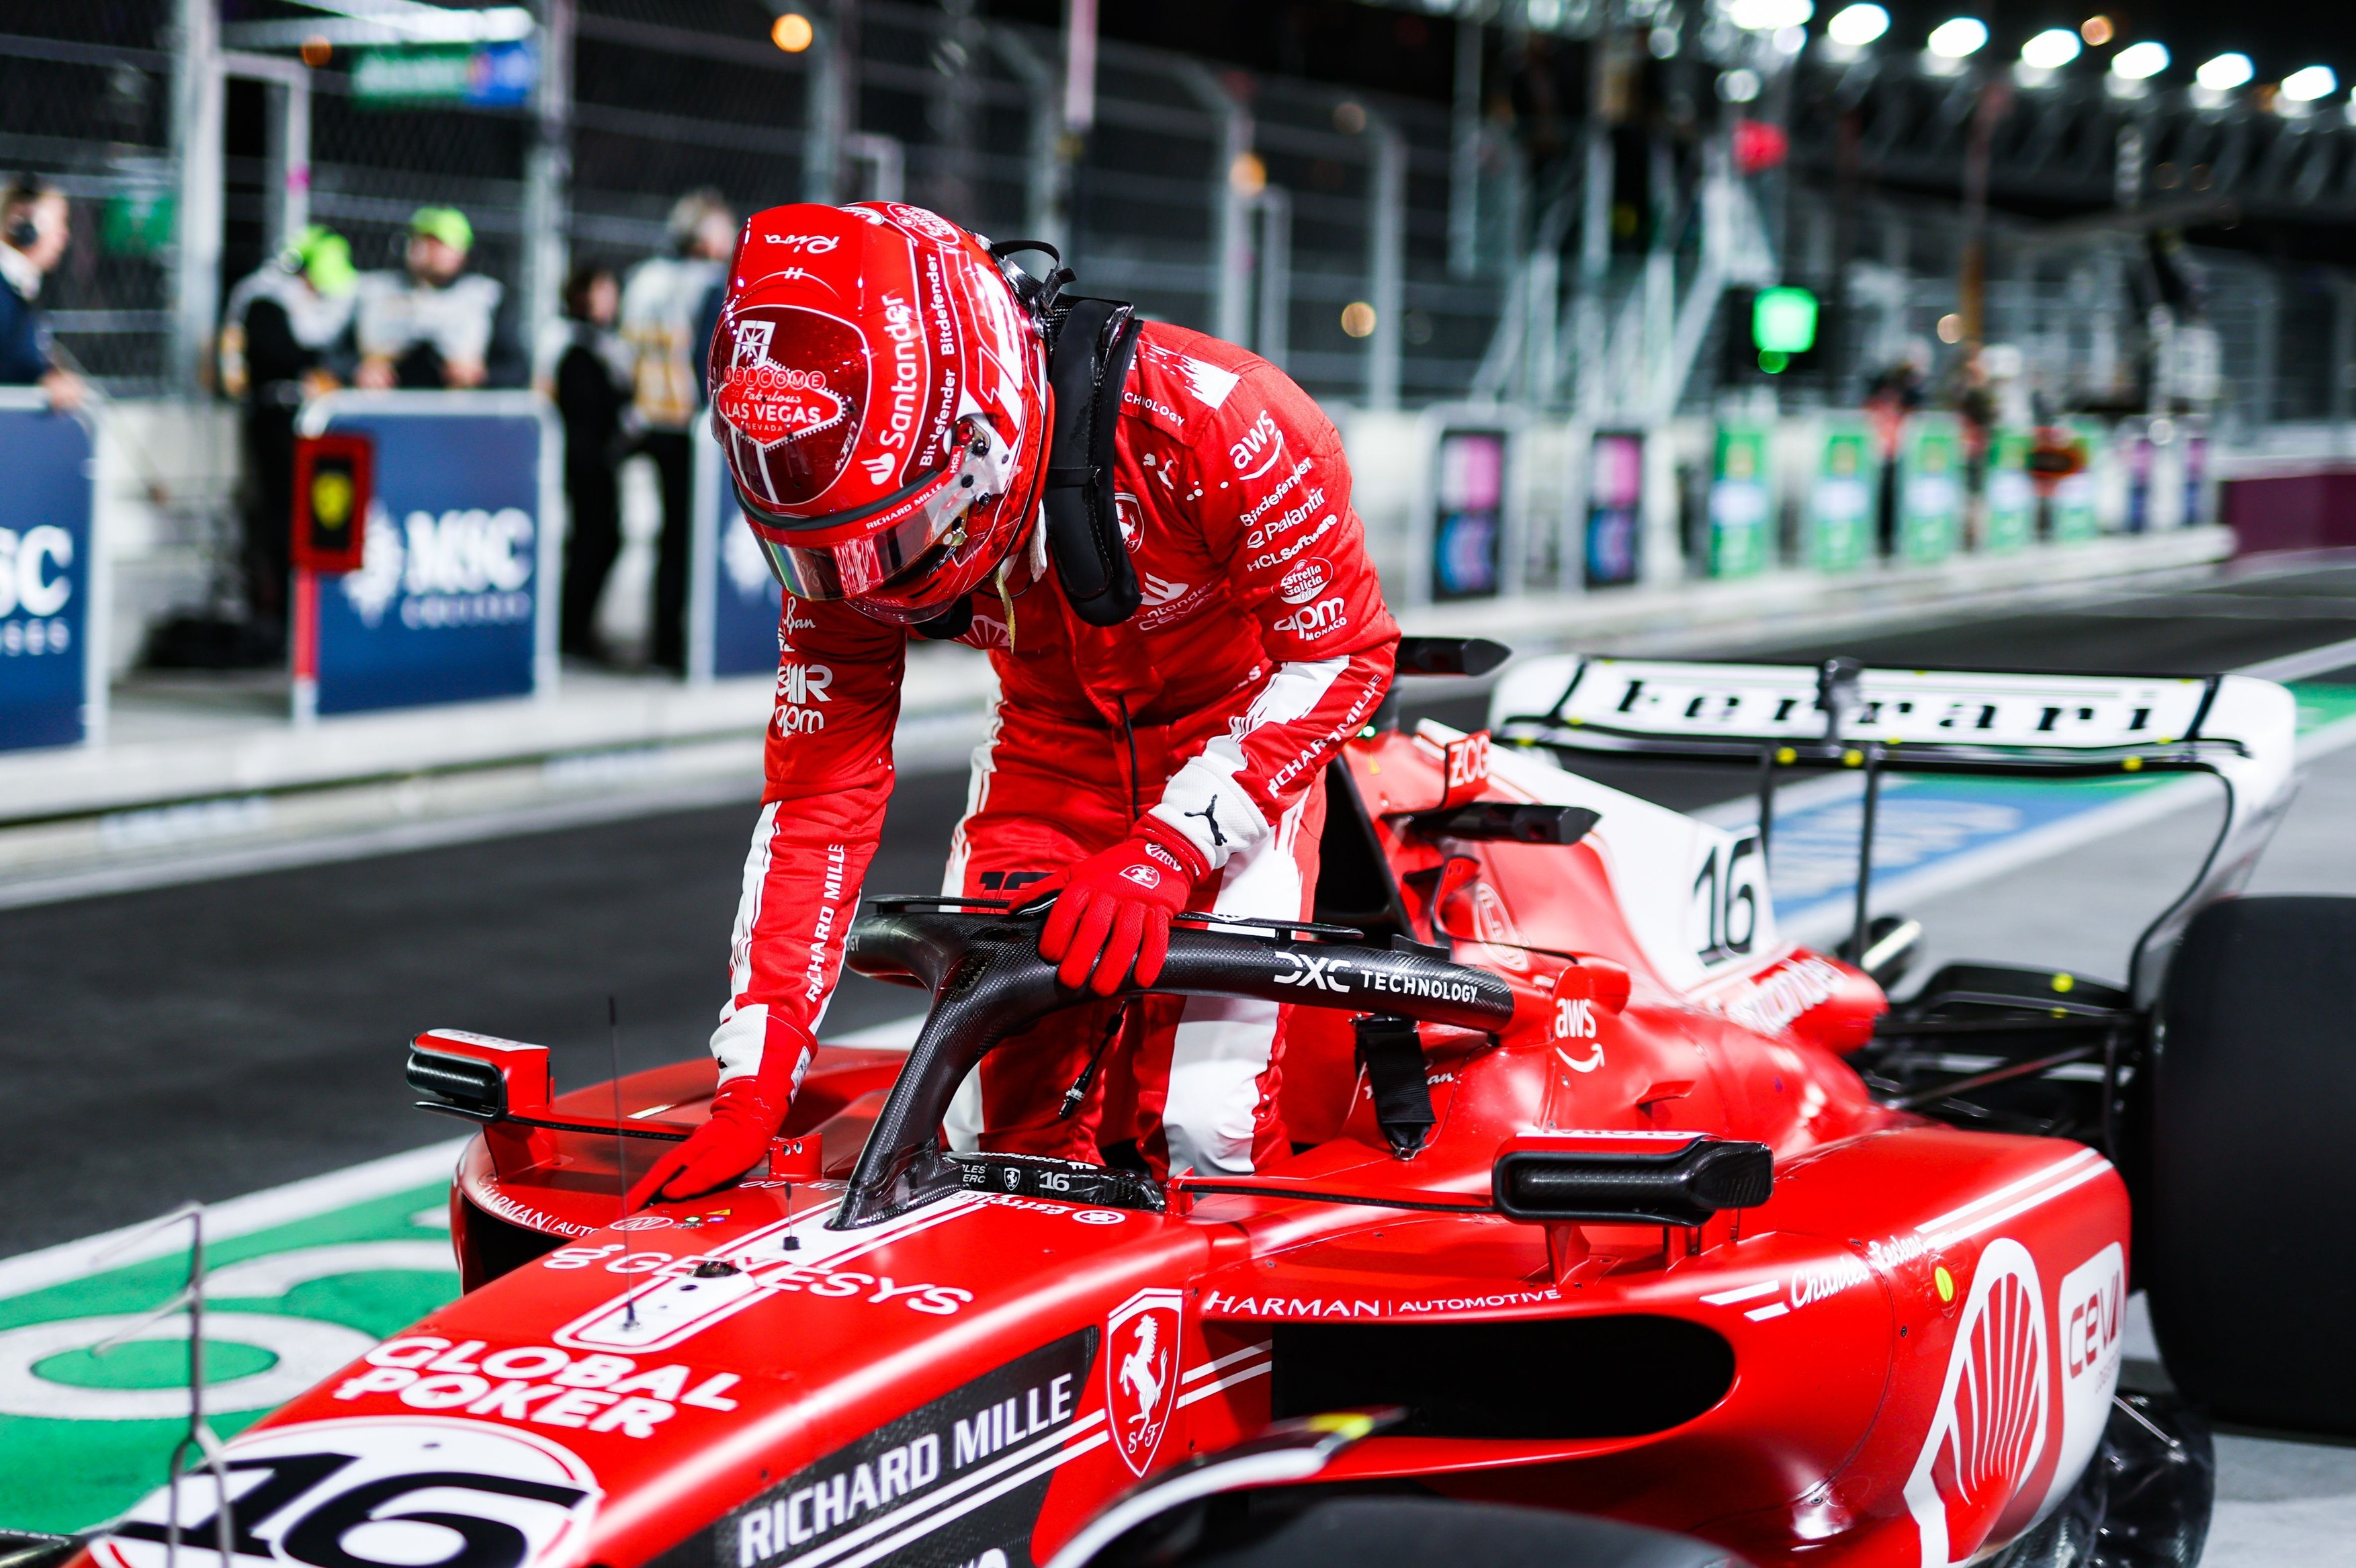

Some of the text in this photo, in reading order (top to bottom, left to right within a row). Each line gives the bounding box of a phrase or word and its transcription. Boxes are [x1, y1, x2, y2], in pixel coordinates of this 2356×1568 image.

[765, 234, 840, 254] Riva
[926, 253, 955, 356] Bitdefender
[724, 365, 826, 390] WELCOME
[742, 387, 802, 404] Fabulous
[879, 294, 918, 449] Santander
[725, 402, 821, 424] LAS VEGAS
[746, 422, 784, 433] NEVADA
[1229, 409, 1276, 470] aws
[865, 503, 912, 530] RICHARD
[913, 482, 943, 507] MILLE
[1239, 456, 1313, 527] Bitdefender
[1264, 487, 1325, 541] Palantir
[1246, 514, 1338, 572] HCLSoftware
[1280, 564, 1322, 587] Estrella
[1284, 575, 1323, 596] Galicia
[1274, 597, 1345, 640] apm
[1305, 617, 1348, 642] MONACO
[775, 704, 824, 738] apm
[1336, 673, 1383, 734] MILLE
[805, 844, 845, 1003] RICHARD MILLE
[1694, 836, 1757, 967] 16
[1273, 951, 1478, 1004] DXC TECHNOLOGY
[1555, 998, 1597, 1039] aws
[1039, 1171, 1071, 1192] 16
[475, 1185, 548, 1231] HARMAN
[606, 1249, 975, 1317] GENESYS
[1207, 1289, 1562, 1317] HARMAN AUTOMOTIVE
[1790, 1255, 1870, 1309] Charles
[364, 1336, 742, 1413] GLOBAL
[333, 1367, 676, 1440] POKER
[1128, 1430, 1137, 1454] S
[737, 1372, 1074, 1568] RICHARD MILLE
[111, 1450, 591, 1568] 16
